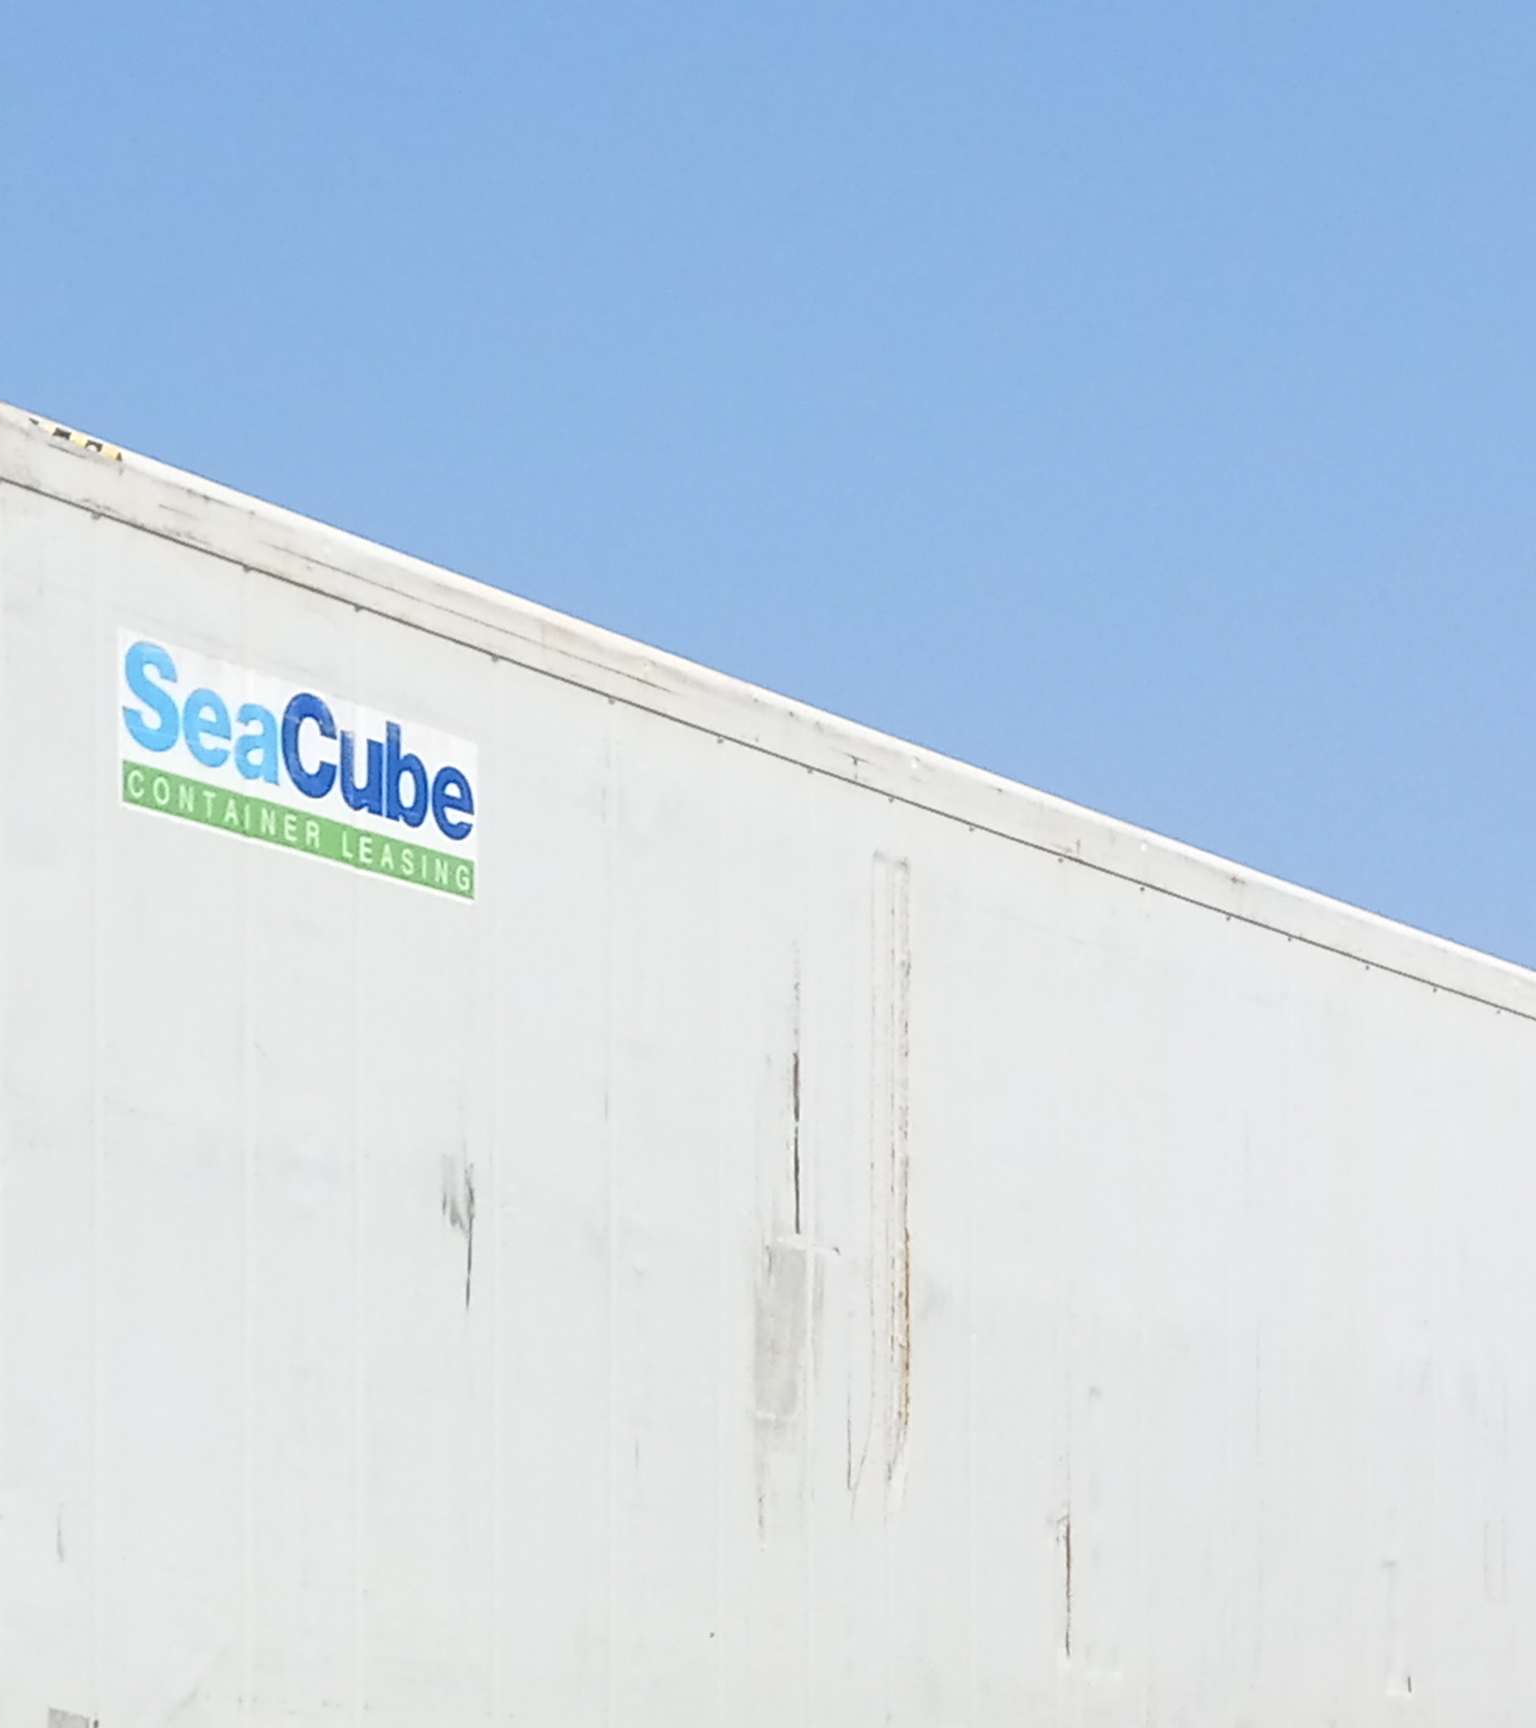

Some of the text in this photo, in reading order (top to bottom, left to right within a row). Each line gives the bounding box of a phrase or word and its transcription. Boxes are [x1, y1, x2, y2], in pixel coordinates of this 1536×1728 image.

[122, 640, 475, 841] SeaCube
[127, 769, 471, 892] CONTAINER LEASING
